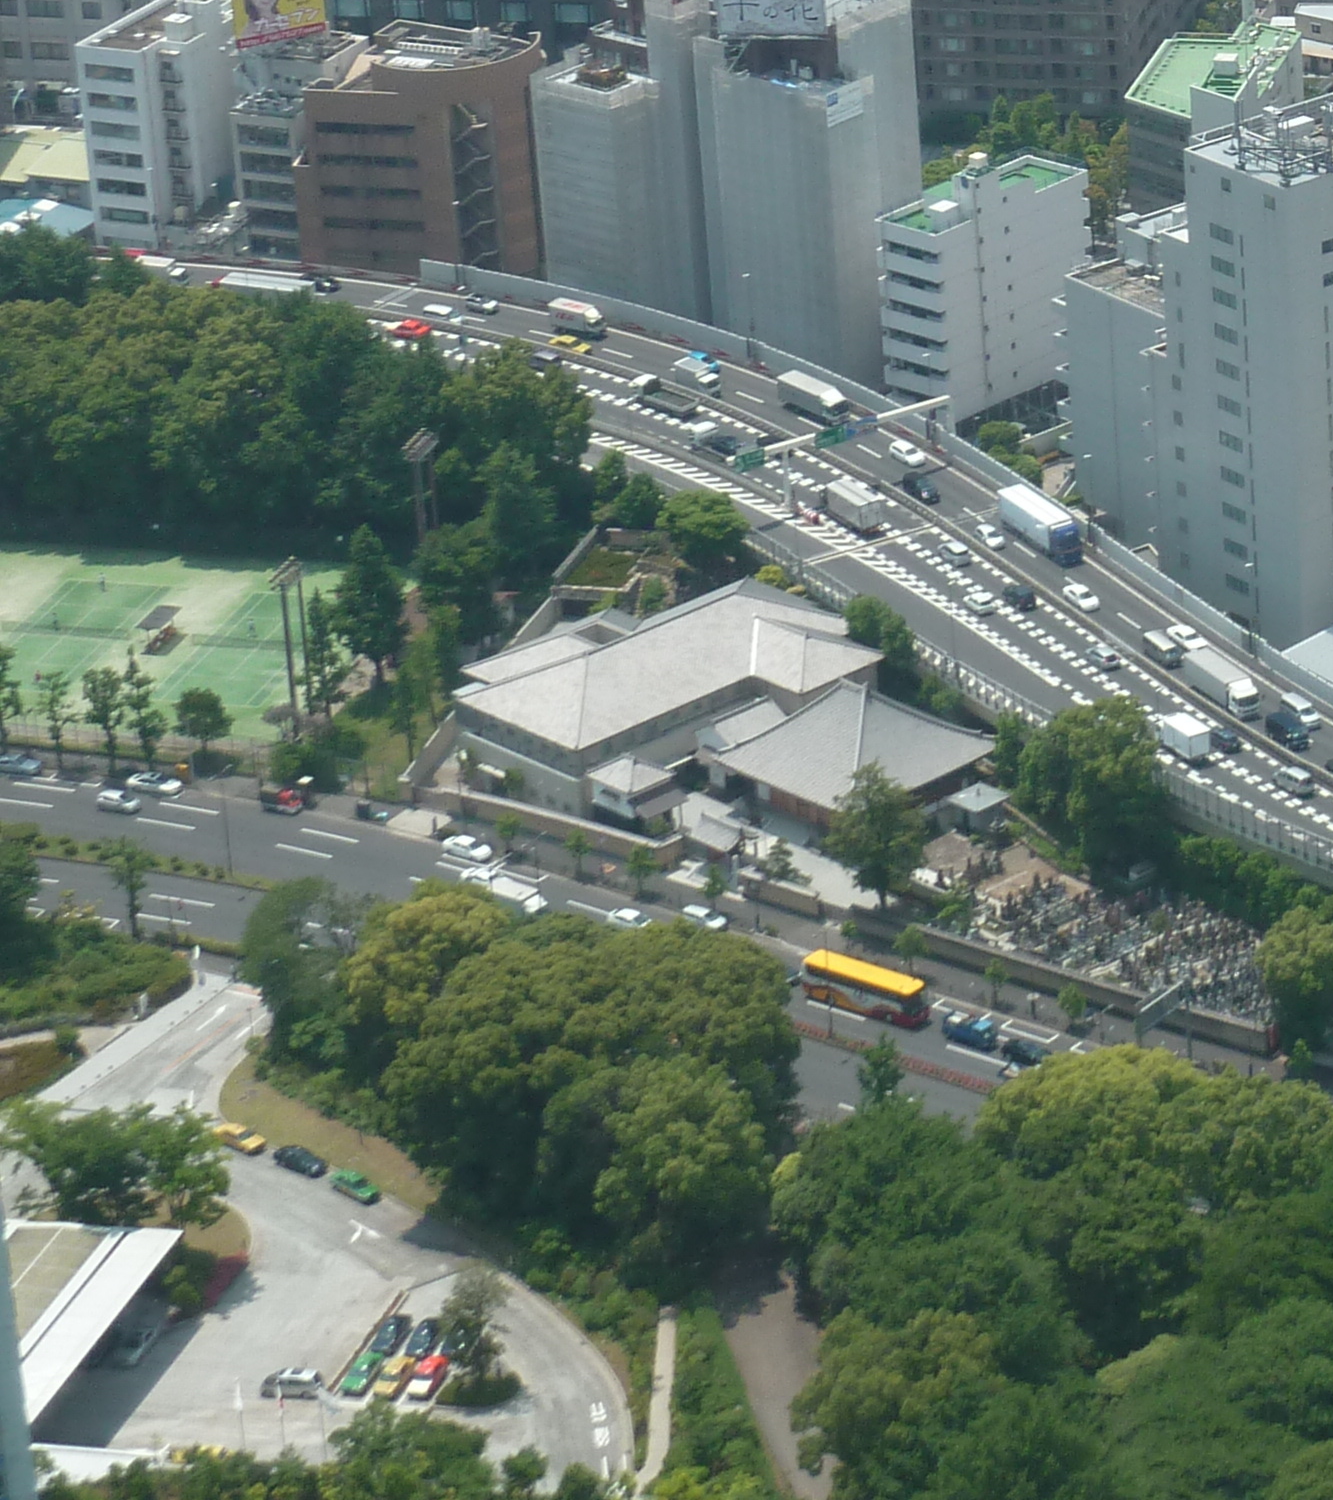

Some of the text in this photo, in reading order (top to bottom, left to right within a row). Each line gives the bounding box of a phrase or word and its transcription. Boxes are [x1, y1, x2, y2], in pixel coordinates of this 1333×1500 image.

[254, 8, 320, 32] カーセブン
